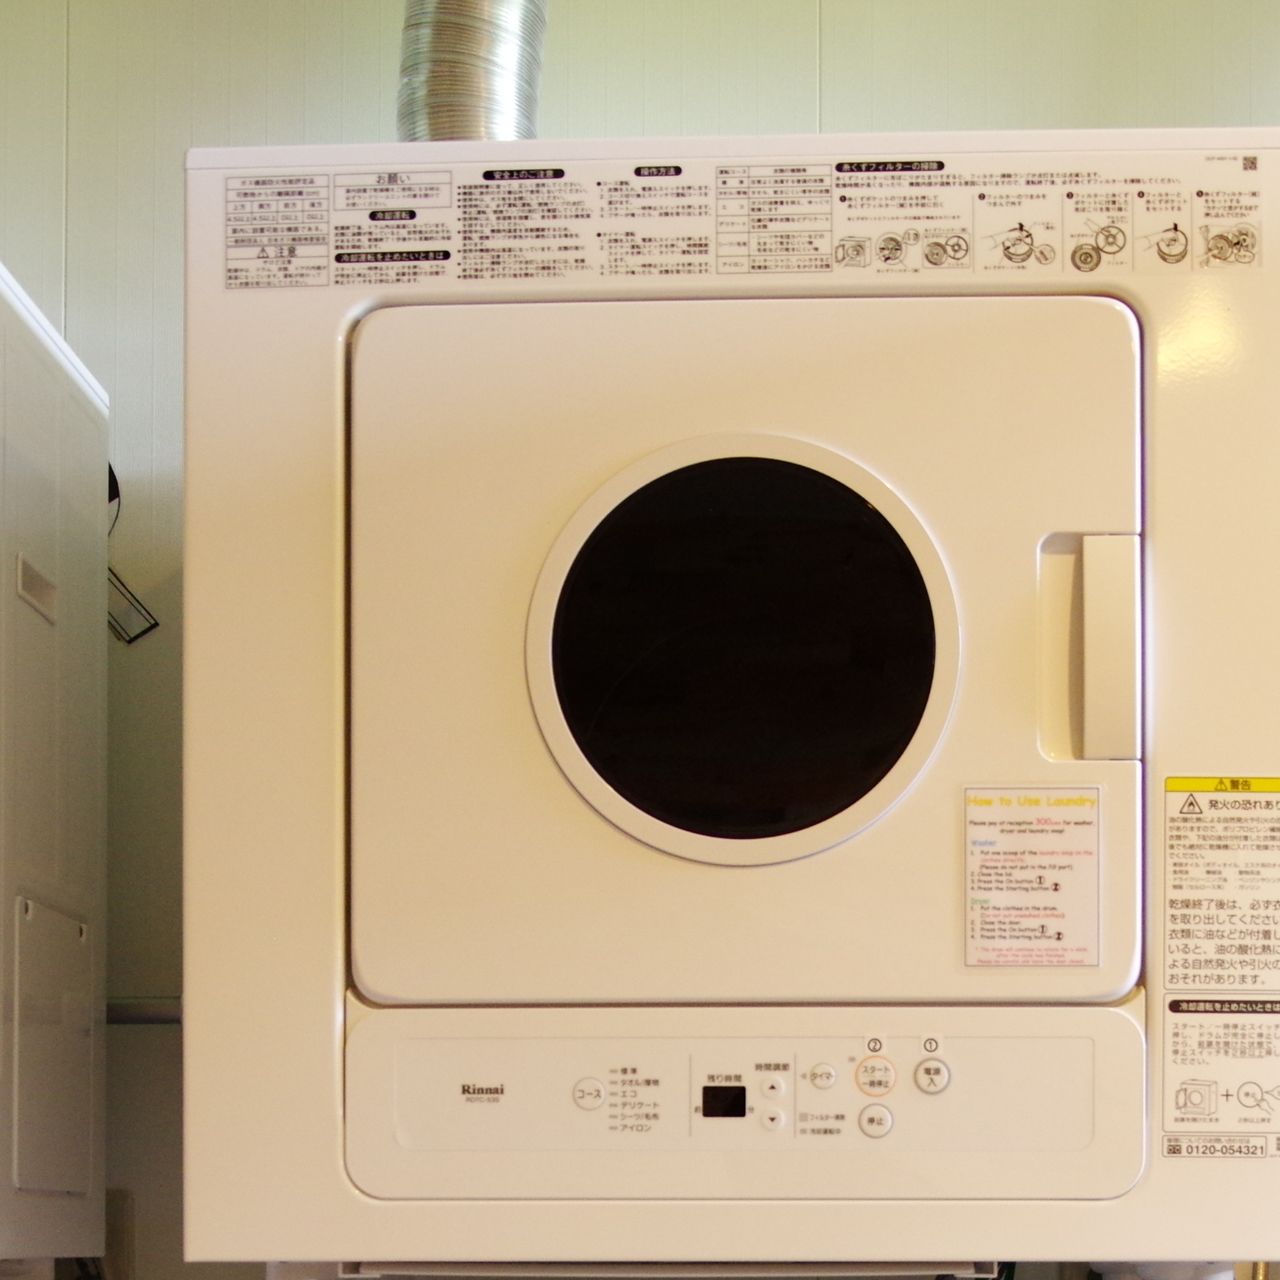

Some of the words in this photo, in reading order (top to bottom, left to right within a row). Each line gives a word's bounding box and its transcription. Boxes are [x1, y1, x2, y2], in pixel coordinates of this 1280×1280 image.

[376, 173, 410, 184] お願い
[494, 170, 553, 178] 安全上のご注意
[275, 247, 297, 258] 注意
[341, 252, 444, 262] 冷却運転を止めたいときは
[1230, 780, 1251, 790] 警告
[967, 797, 992, 806] How
[1000, 797, 1012, 806] to
[1018, 797, 1040, 806] Use
[1047, 795, 1096, 808] Laundry
[1169, 974, 1266, 984] おそれがあります。
[1180, 1003, 1280, 1011] 冷却運転を止めたいときは
[755, 1063, 790, 1071] 時間調節
[924, 1068, 941, 1076] 電源
[927, 1078, 937, 1087] 入
[461, 1084, 504, 1095] Rinnai
[578, 1090, 602, 1099] コース
[867, 1117, 883, 1126] 停止
[1187, 1146, 1264, 1155] 0120-054321
